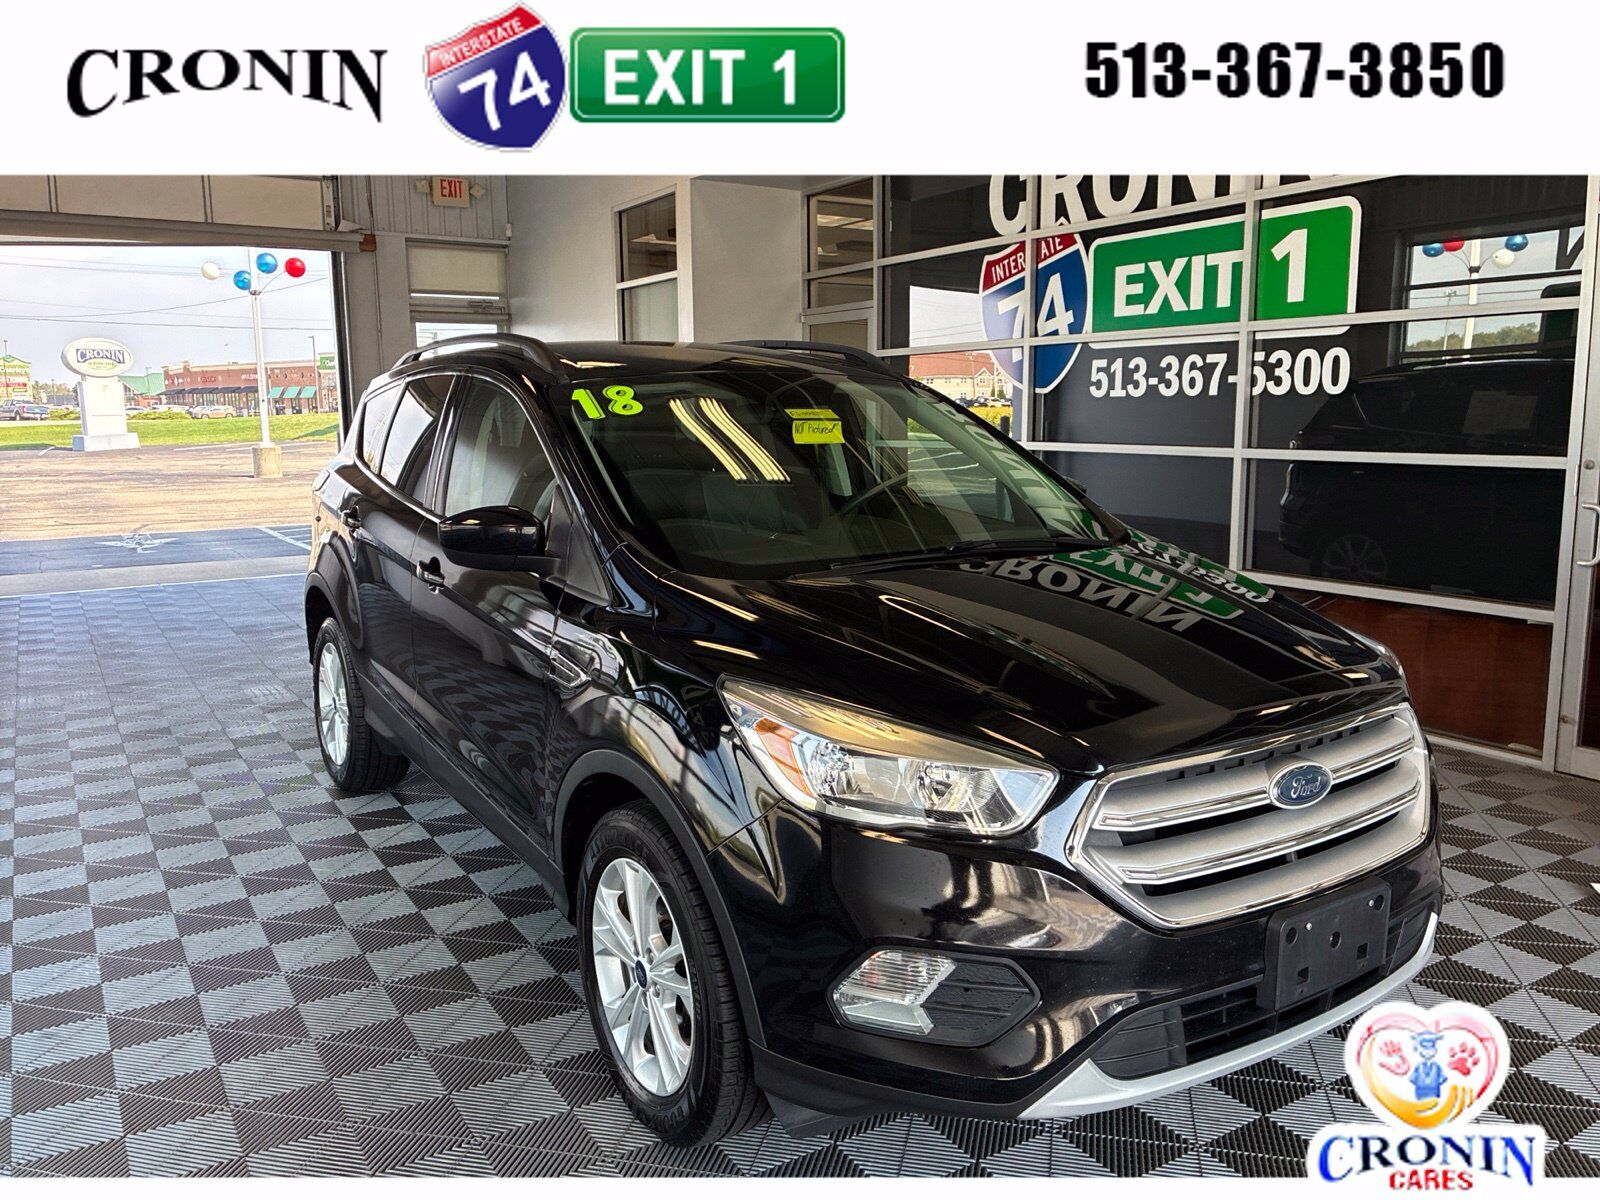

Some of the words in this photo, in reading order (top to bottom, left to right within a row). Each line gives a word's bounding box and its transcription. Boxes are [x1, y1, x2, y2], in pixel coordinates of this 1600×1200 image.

[440, 178, 463, 198] EXIT
[991, 236, 1064, 284] INTERATE
[1113, 250, 1244, 318] EXIT
[1270, 228, 1308, 303] 1
[997, 271, 1075, 363] 74
[77, 349, 124, 364] CRONIN
[1089, 347, 1350, 398] 513-367-5300
[571, 385, 643, 419] 18
[1290, 774, 1321, 798] Ford
